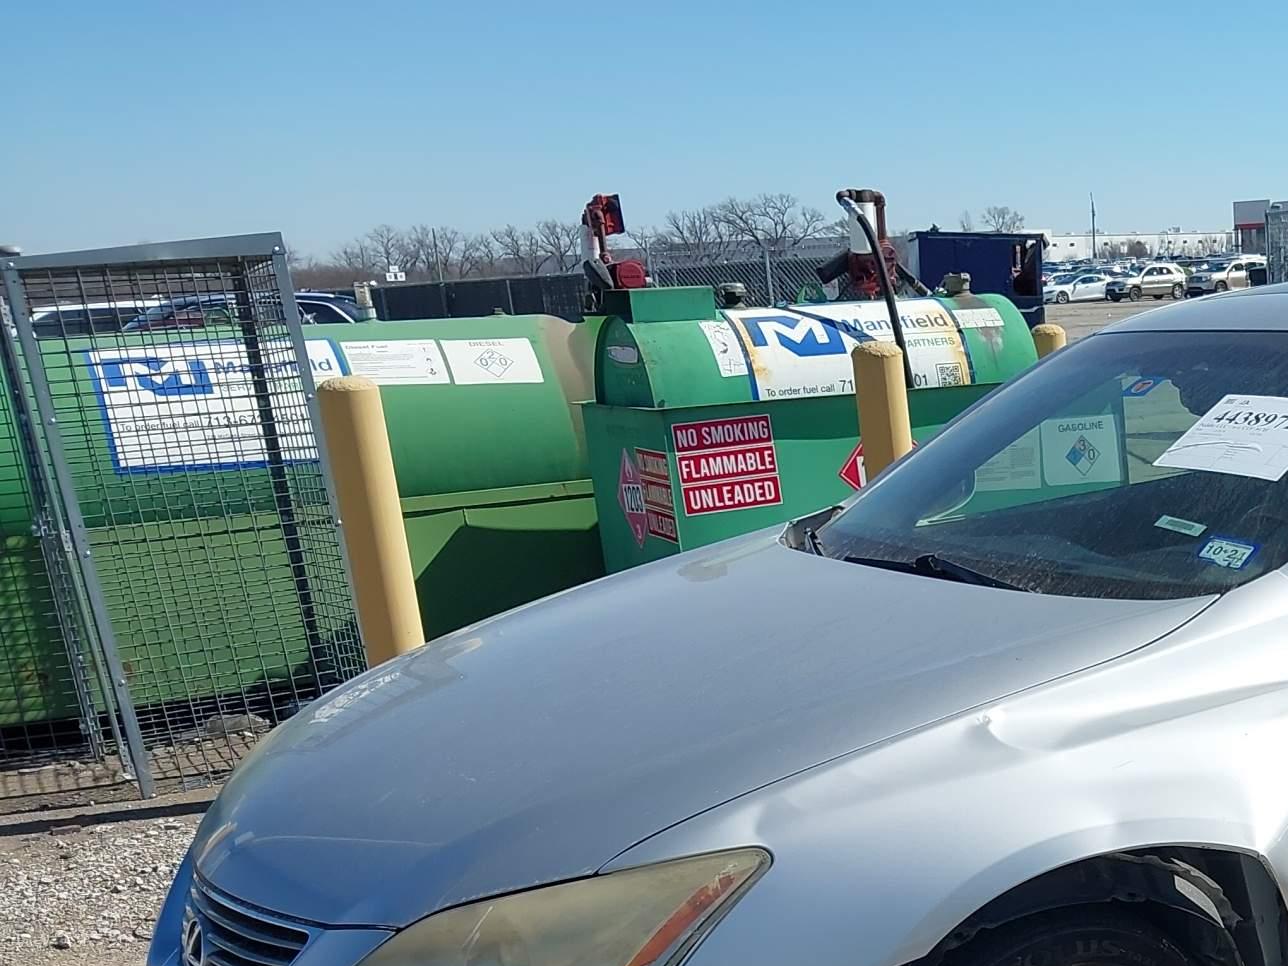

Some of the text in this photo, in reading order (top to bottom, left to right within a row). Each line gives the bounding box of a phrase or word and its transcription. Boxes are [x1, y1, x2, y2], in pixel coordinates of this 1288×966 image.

[843, 313, 948, 332] Manfield
[468, 340, 505, 348] DIESEL
[906, 337, 955, 348] ARTNERS
[765, 388, 777, 397] To
[778, 386, 800, 397] order
[803, 384, 819, 395] fuel
[820, 383, 835, 394] call
[676, 420, 769, 448] NO SMOKING
[1058, 420, 1104, 433] GASOLINE
[681, 450, 774, 480] FLAMMABLE
[624, 484, 644, 513] 1203
[689, 481, 775, 510] UNLEADED
